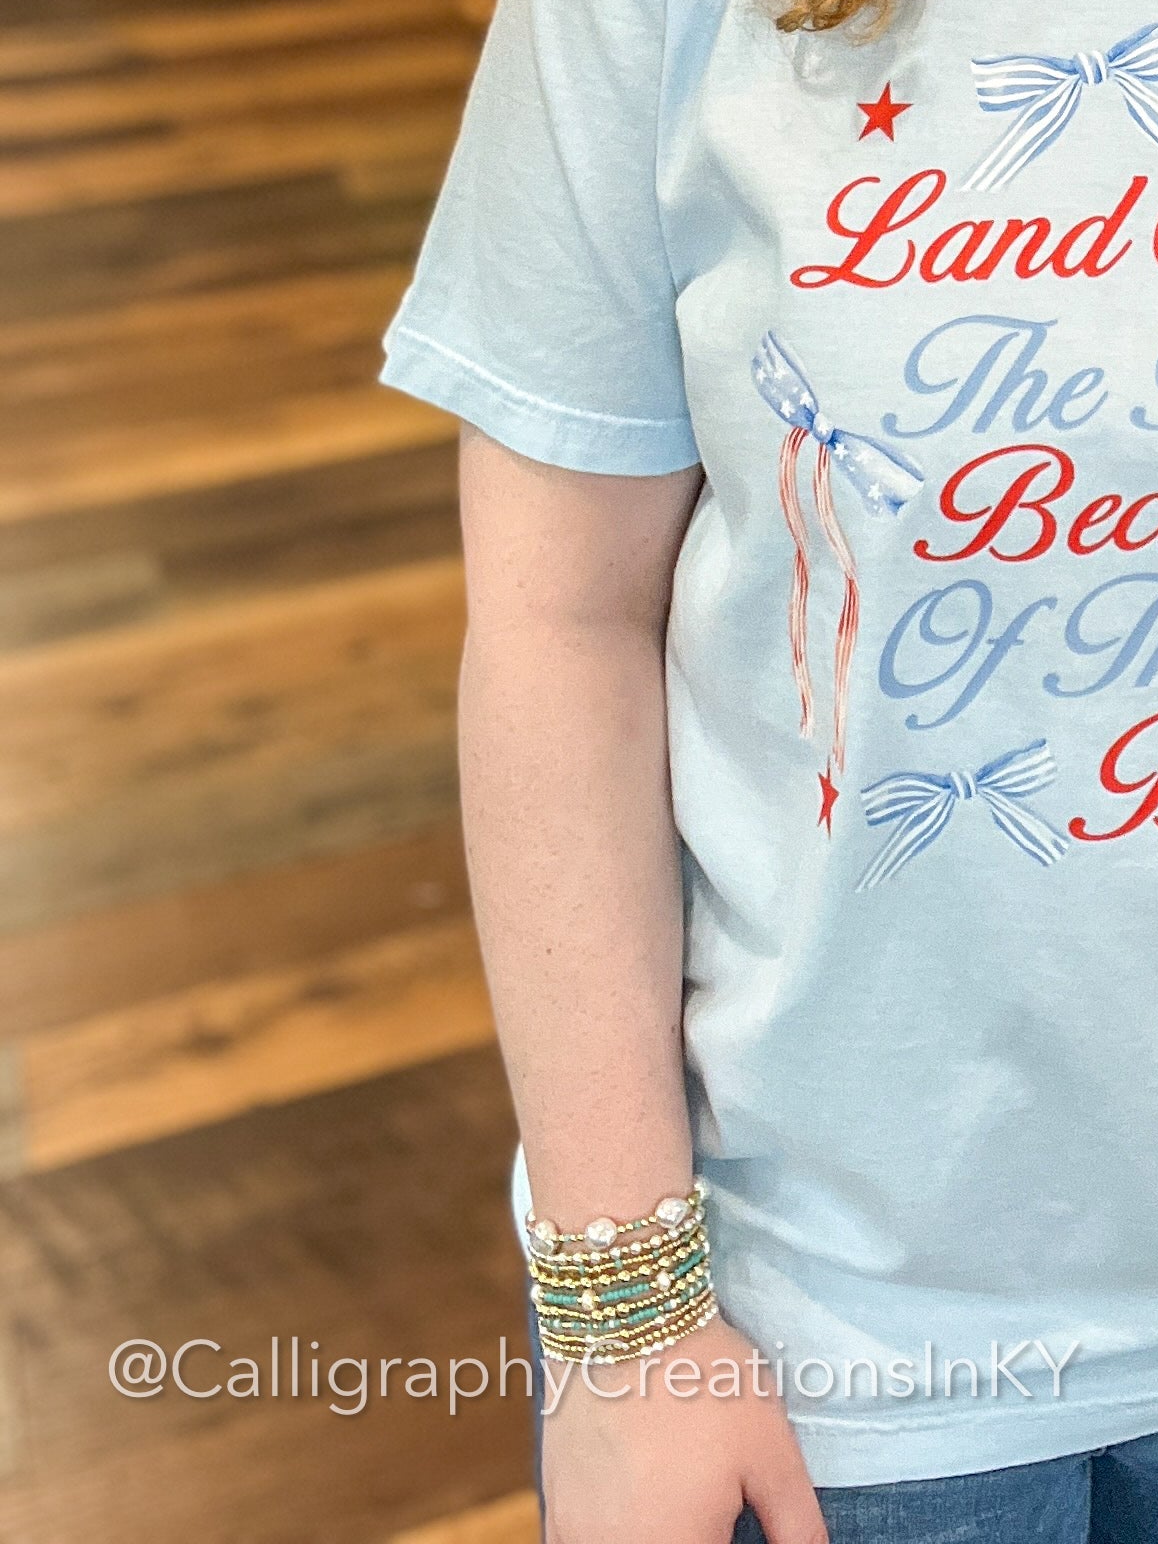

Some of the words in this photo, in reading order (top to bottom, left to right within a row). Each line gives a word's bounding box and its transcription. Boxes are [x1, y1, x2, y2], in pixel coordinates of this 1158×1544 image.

[789, 167, 1149, 290] Land
[882, 313, 1110, 439] The
[877, 578, 1058, 732] Of
